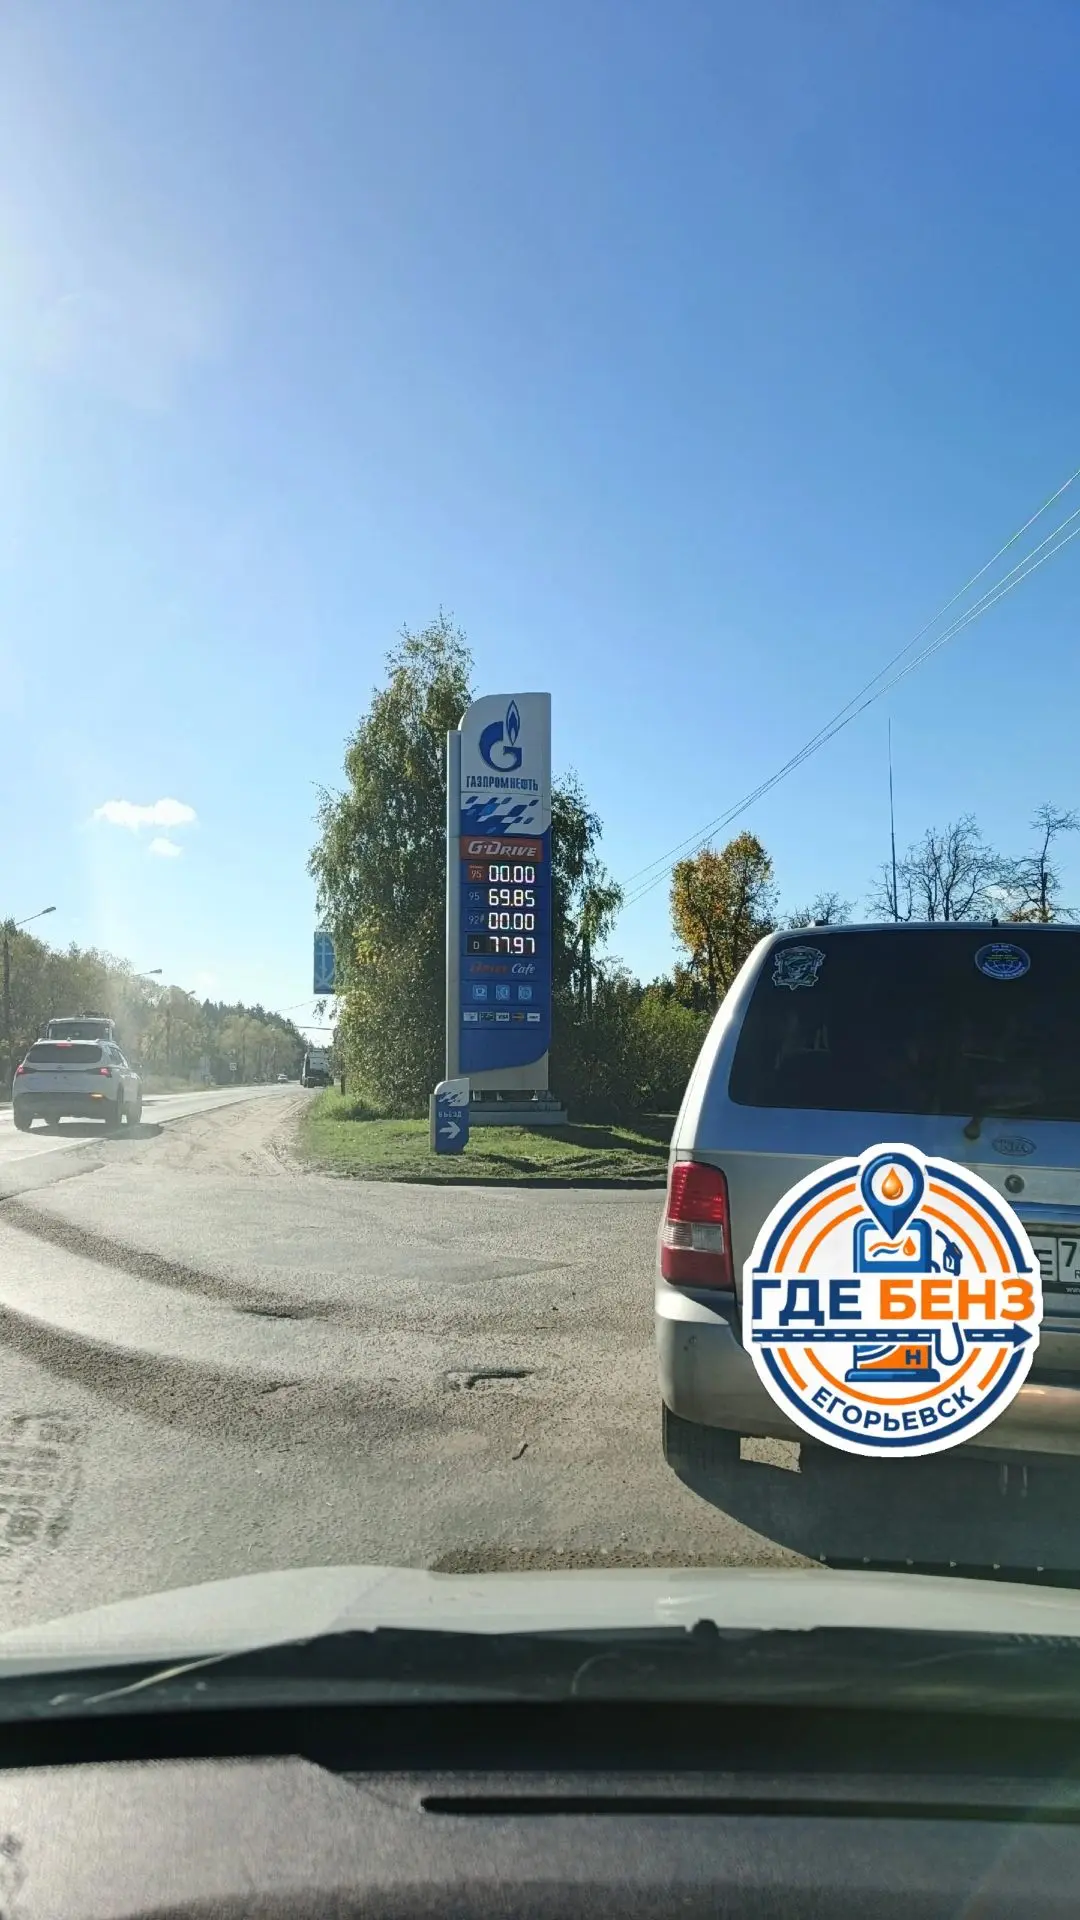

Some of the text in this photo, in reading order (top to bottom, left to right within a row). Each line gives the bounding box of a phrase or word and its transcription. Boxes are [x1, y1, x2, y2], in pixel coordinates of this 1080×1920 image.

[466, 776, 539, 791] ГАЗПРОМНЕФТЬ
[488, 865, 535, 883] 00.00
[468, 888, 535, 907] 95 69.85
[488, 912, 535, 930] 00.00
[489, 936, 535, 954] 77.97
